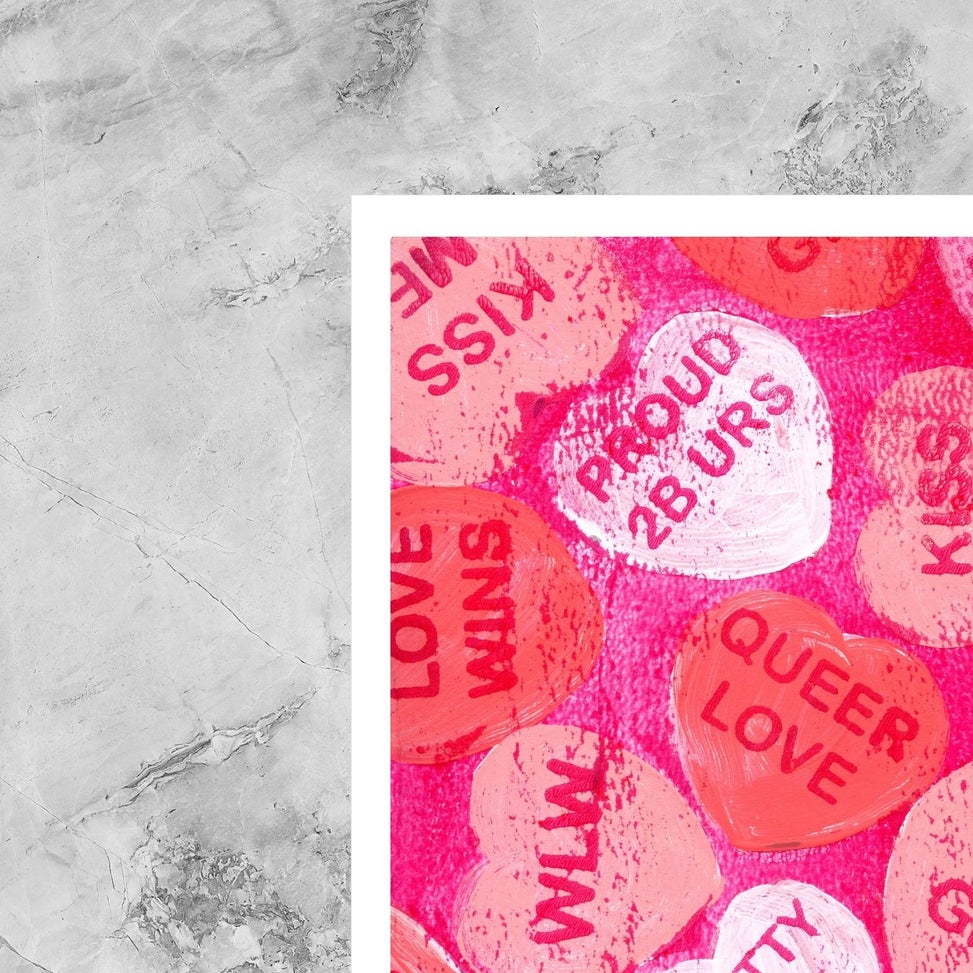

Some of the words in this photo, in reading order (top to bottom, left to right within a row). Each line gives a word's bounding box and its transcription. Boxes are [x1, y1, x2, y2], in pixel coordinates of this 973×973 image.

[391, 237, 478, 319] ME
[407, 242, 555, 396] KISS
[576, 329, 741, 502] PROUD
[627, 476, 697, 549] 2B
[688, 374, 794, 479] URS
[916, 421, 973, 576] KISS
[391, 524, 440, 699] LOVE
[459, 519, 519, 699] WINS
[721, 608, 918, 763] QUEER
[701, 680, 857, 805] LOVE
[535, 757, 601, 945] WLW
